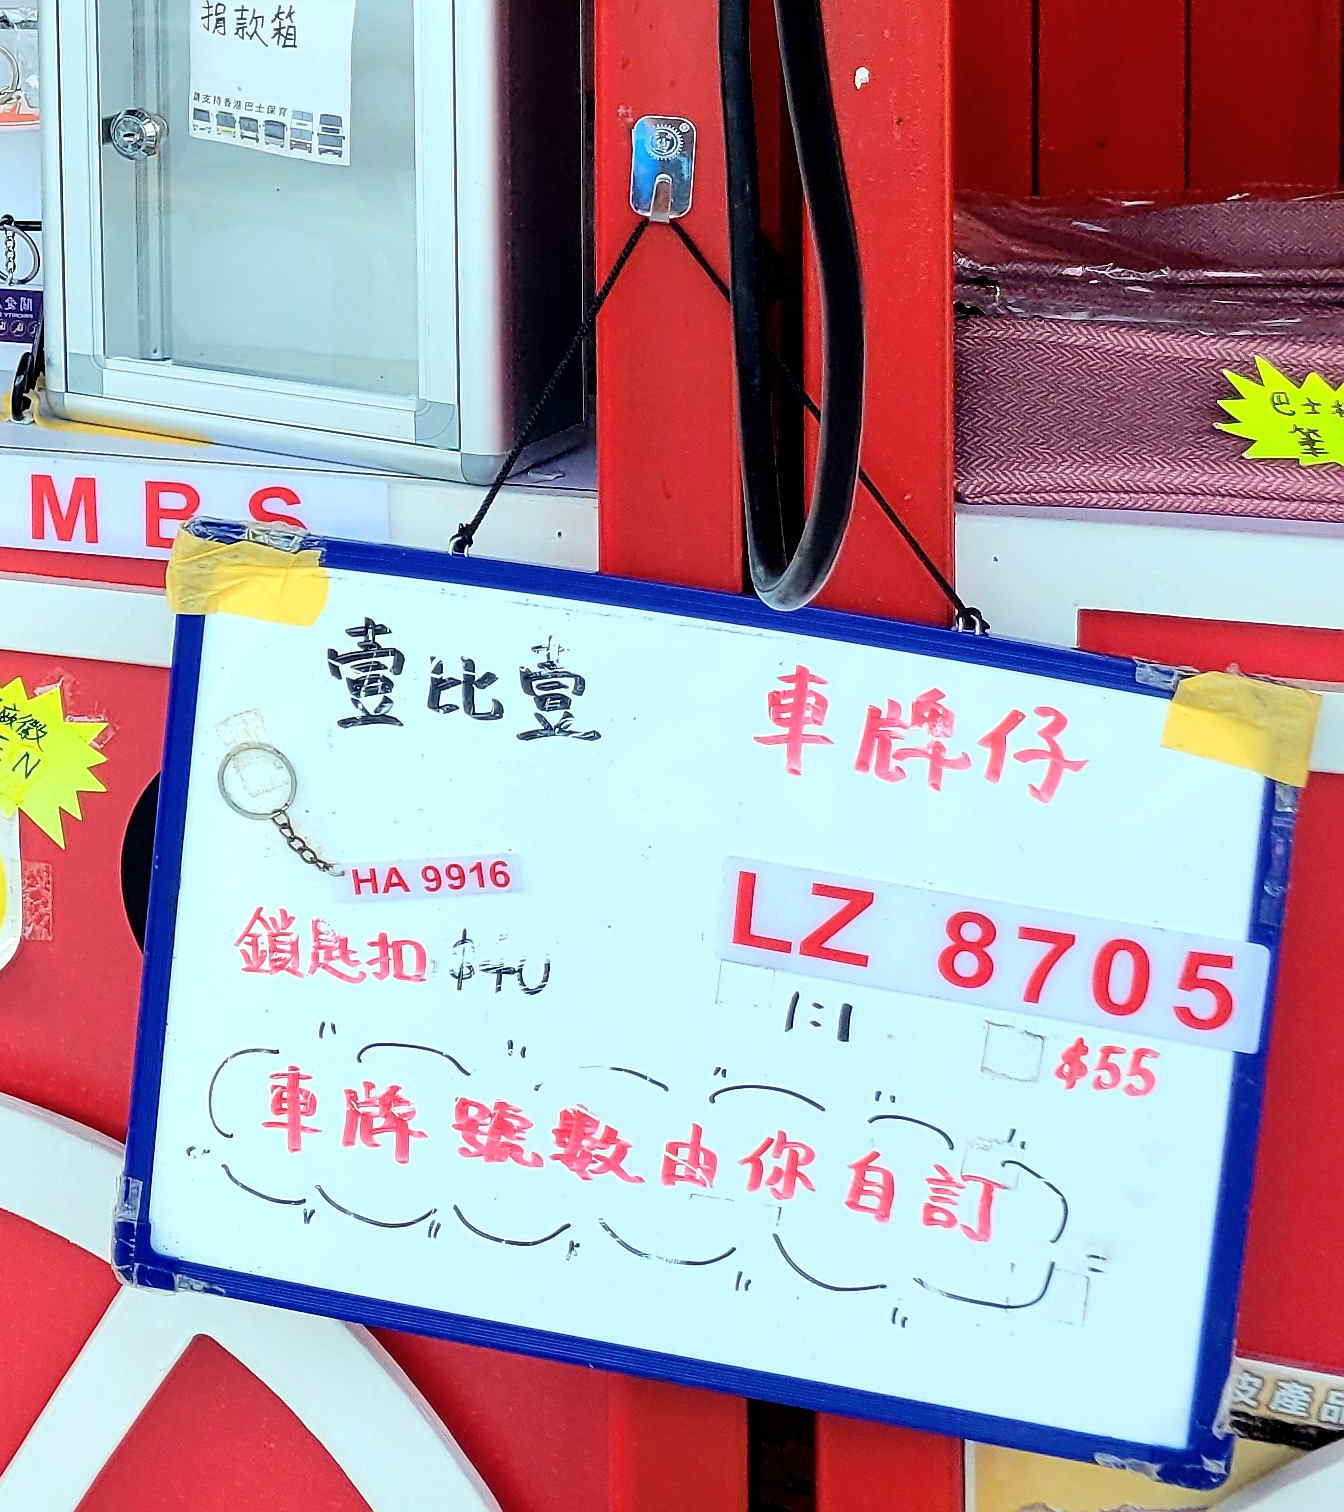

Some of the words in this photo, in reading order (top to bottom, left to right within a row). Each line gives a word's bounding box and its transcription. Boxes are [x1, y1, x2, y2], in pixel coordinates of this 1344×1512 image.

[201, 0, 297, 48] 捐款箱
[327, 616, 602, 742] 壹比壹
[753, 664, 1089, 804] 車牌仔
[351, 866, 411, 897] HA
[420, 859, 511, 893] 9916
[233, 905, 426, 983] 鎖匙扣
[732, 869, 876, 968] LZ
[937, 910, 1235, 1031] 8705
[785, 990, 853, 1043] 1:1
[1053, 1036, 1161, 1097] $55
[262, 1065, 1011, 1243] 車牌號數由你自訂
